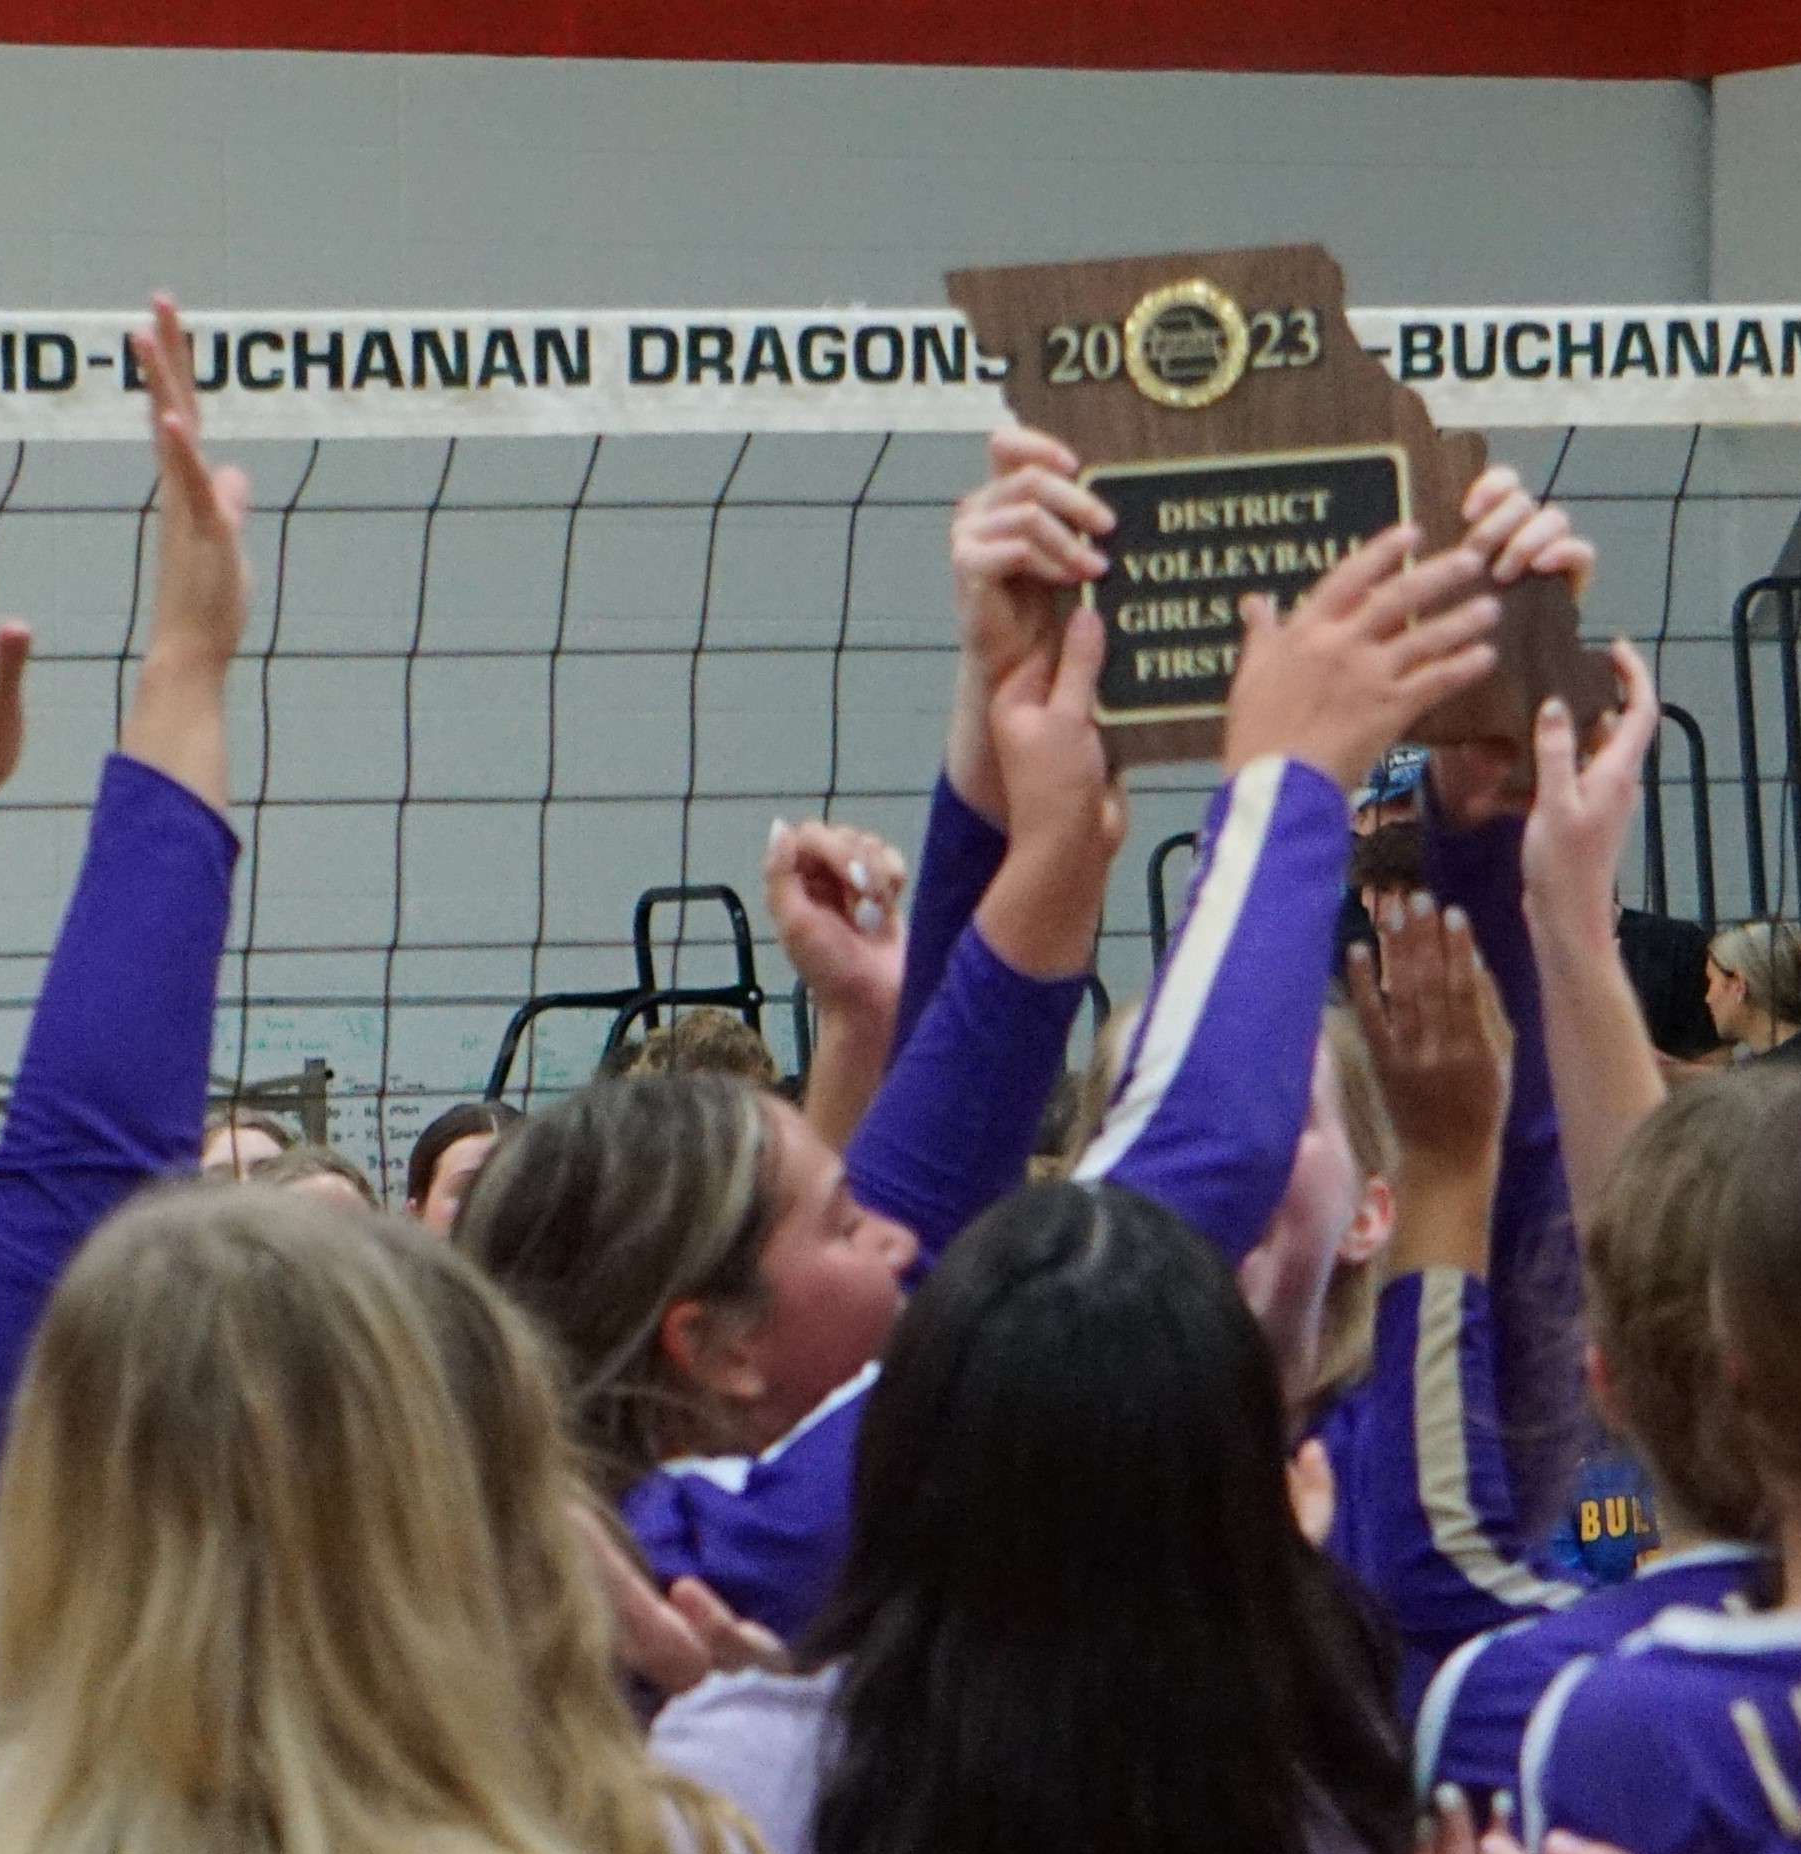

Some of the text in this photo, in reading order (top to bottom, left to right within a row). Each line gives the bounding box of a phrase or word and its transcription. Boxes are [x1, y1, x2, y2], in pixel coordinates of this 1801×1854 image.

[1047, 324, 1120, 384] 20
[1252, 309, 1320, 368] 23
[1157, 489, 1330, 533] DISTRICT
[1117, 597, 1233, 634] GIRLS
[1135, 643, 1238, 682] FIRST
